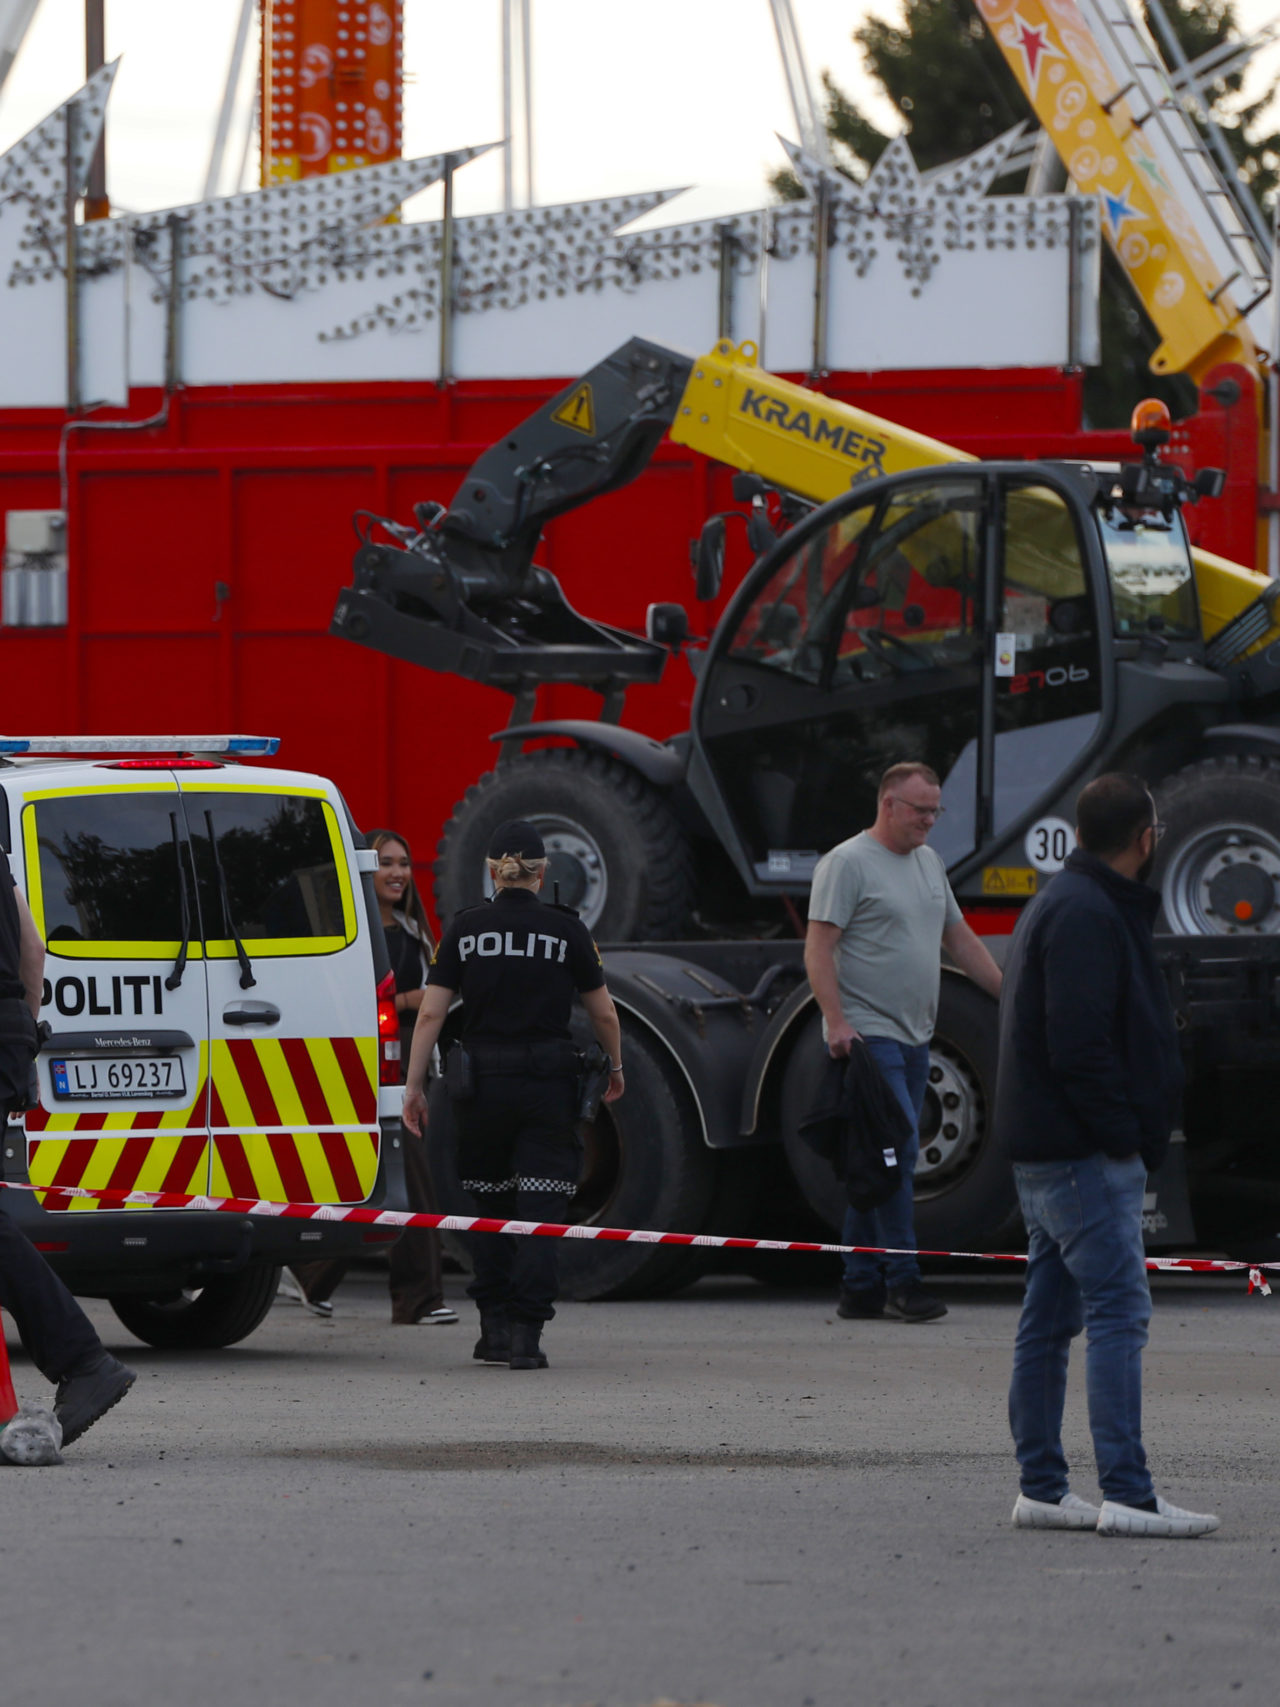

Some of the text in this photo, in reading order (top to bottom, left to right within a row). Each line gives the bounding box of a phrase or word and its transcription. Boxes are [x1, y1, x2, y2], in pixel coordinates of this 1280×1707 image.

[739, 387, 887, 467] KRAMER
[1035, 828, 1067, 861] 30
[458, 931, 568, 963] POLITI
[95, 1037, 152, 1047] Mercedes-Benz
[59, 1081, 66, 1089] N
[74, 1062, 172, 1089] LJ 69237
